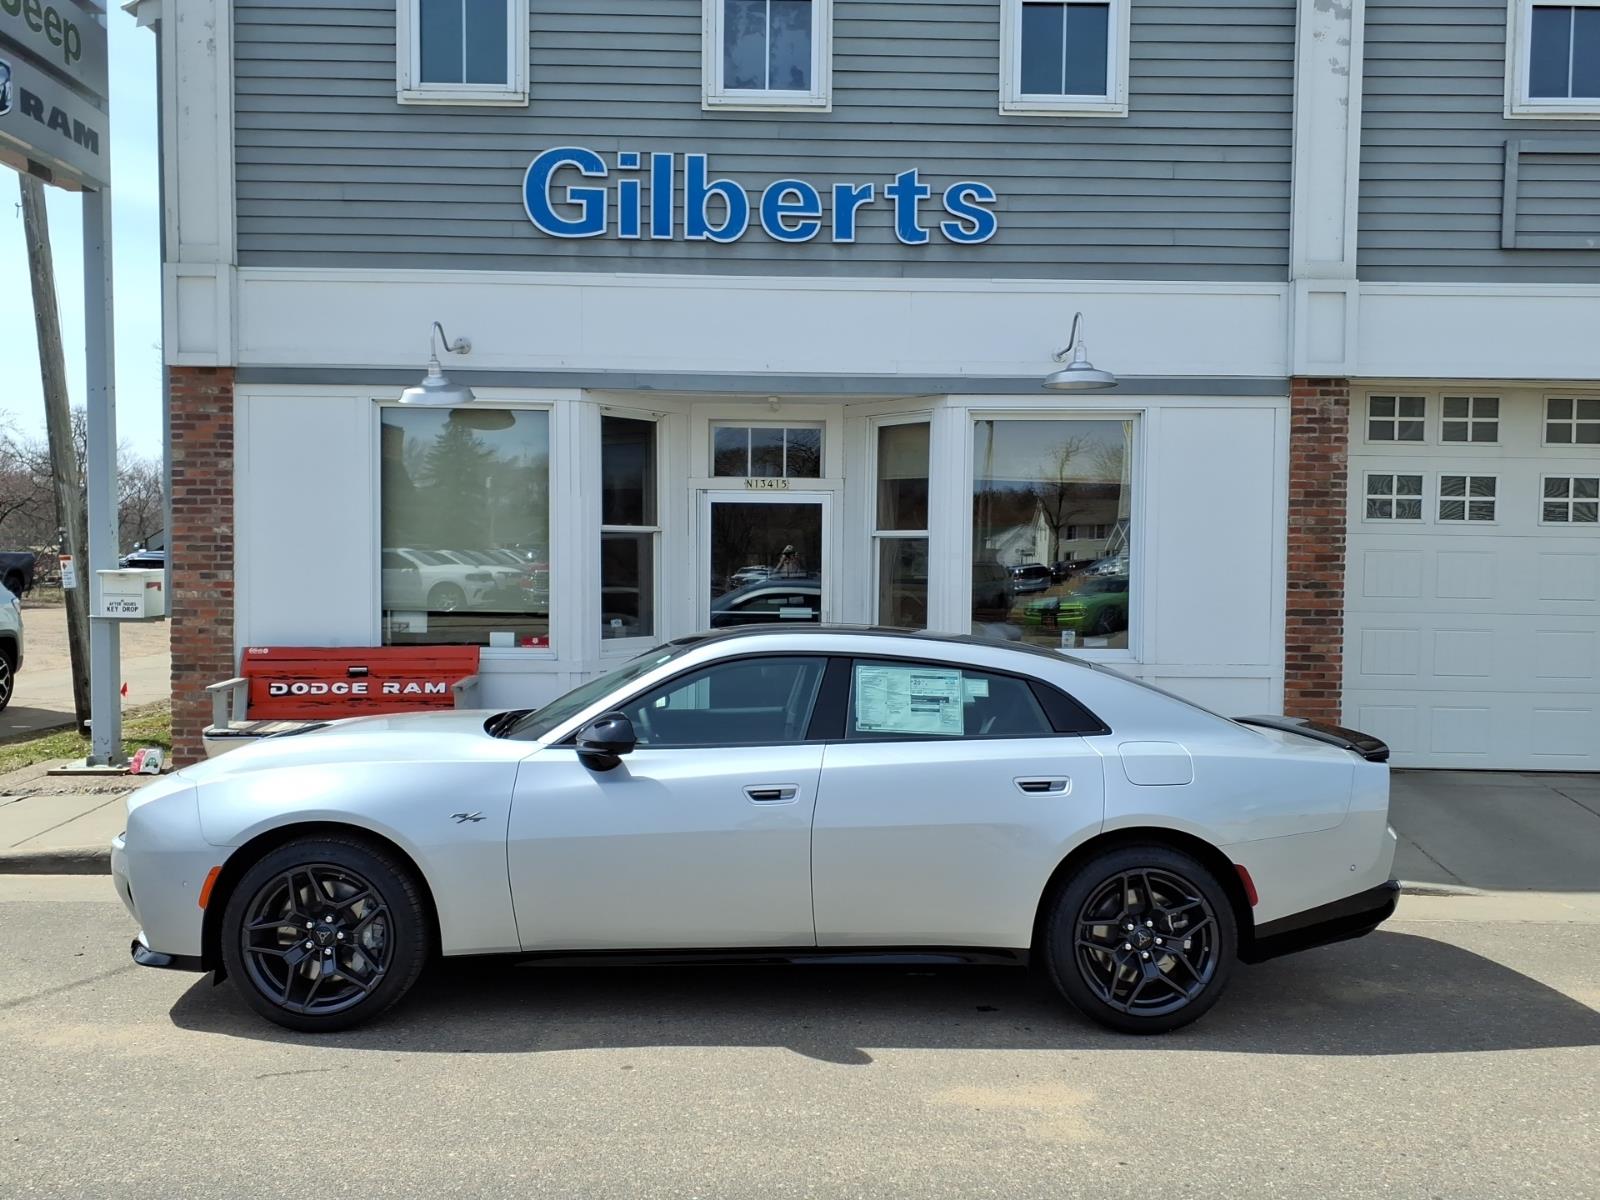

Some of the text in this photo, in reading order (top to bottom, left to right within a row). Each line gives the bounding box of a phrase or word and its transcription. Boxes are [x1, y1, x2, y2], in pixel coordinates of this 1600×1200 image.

[19, 86, 100, 156] RAM
[522, 146, 999, 246] Gilberts
[746, 479, 788, 489] N13415
[269, 682, 446, 695] DODGE RAM
